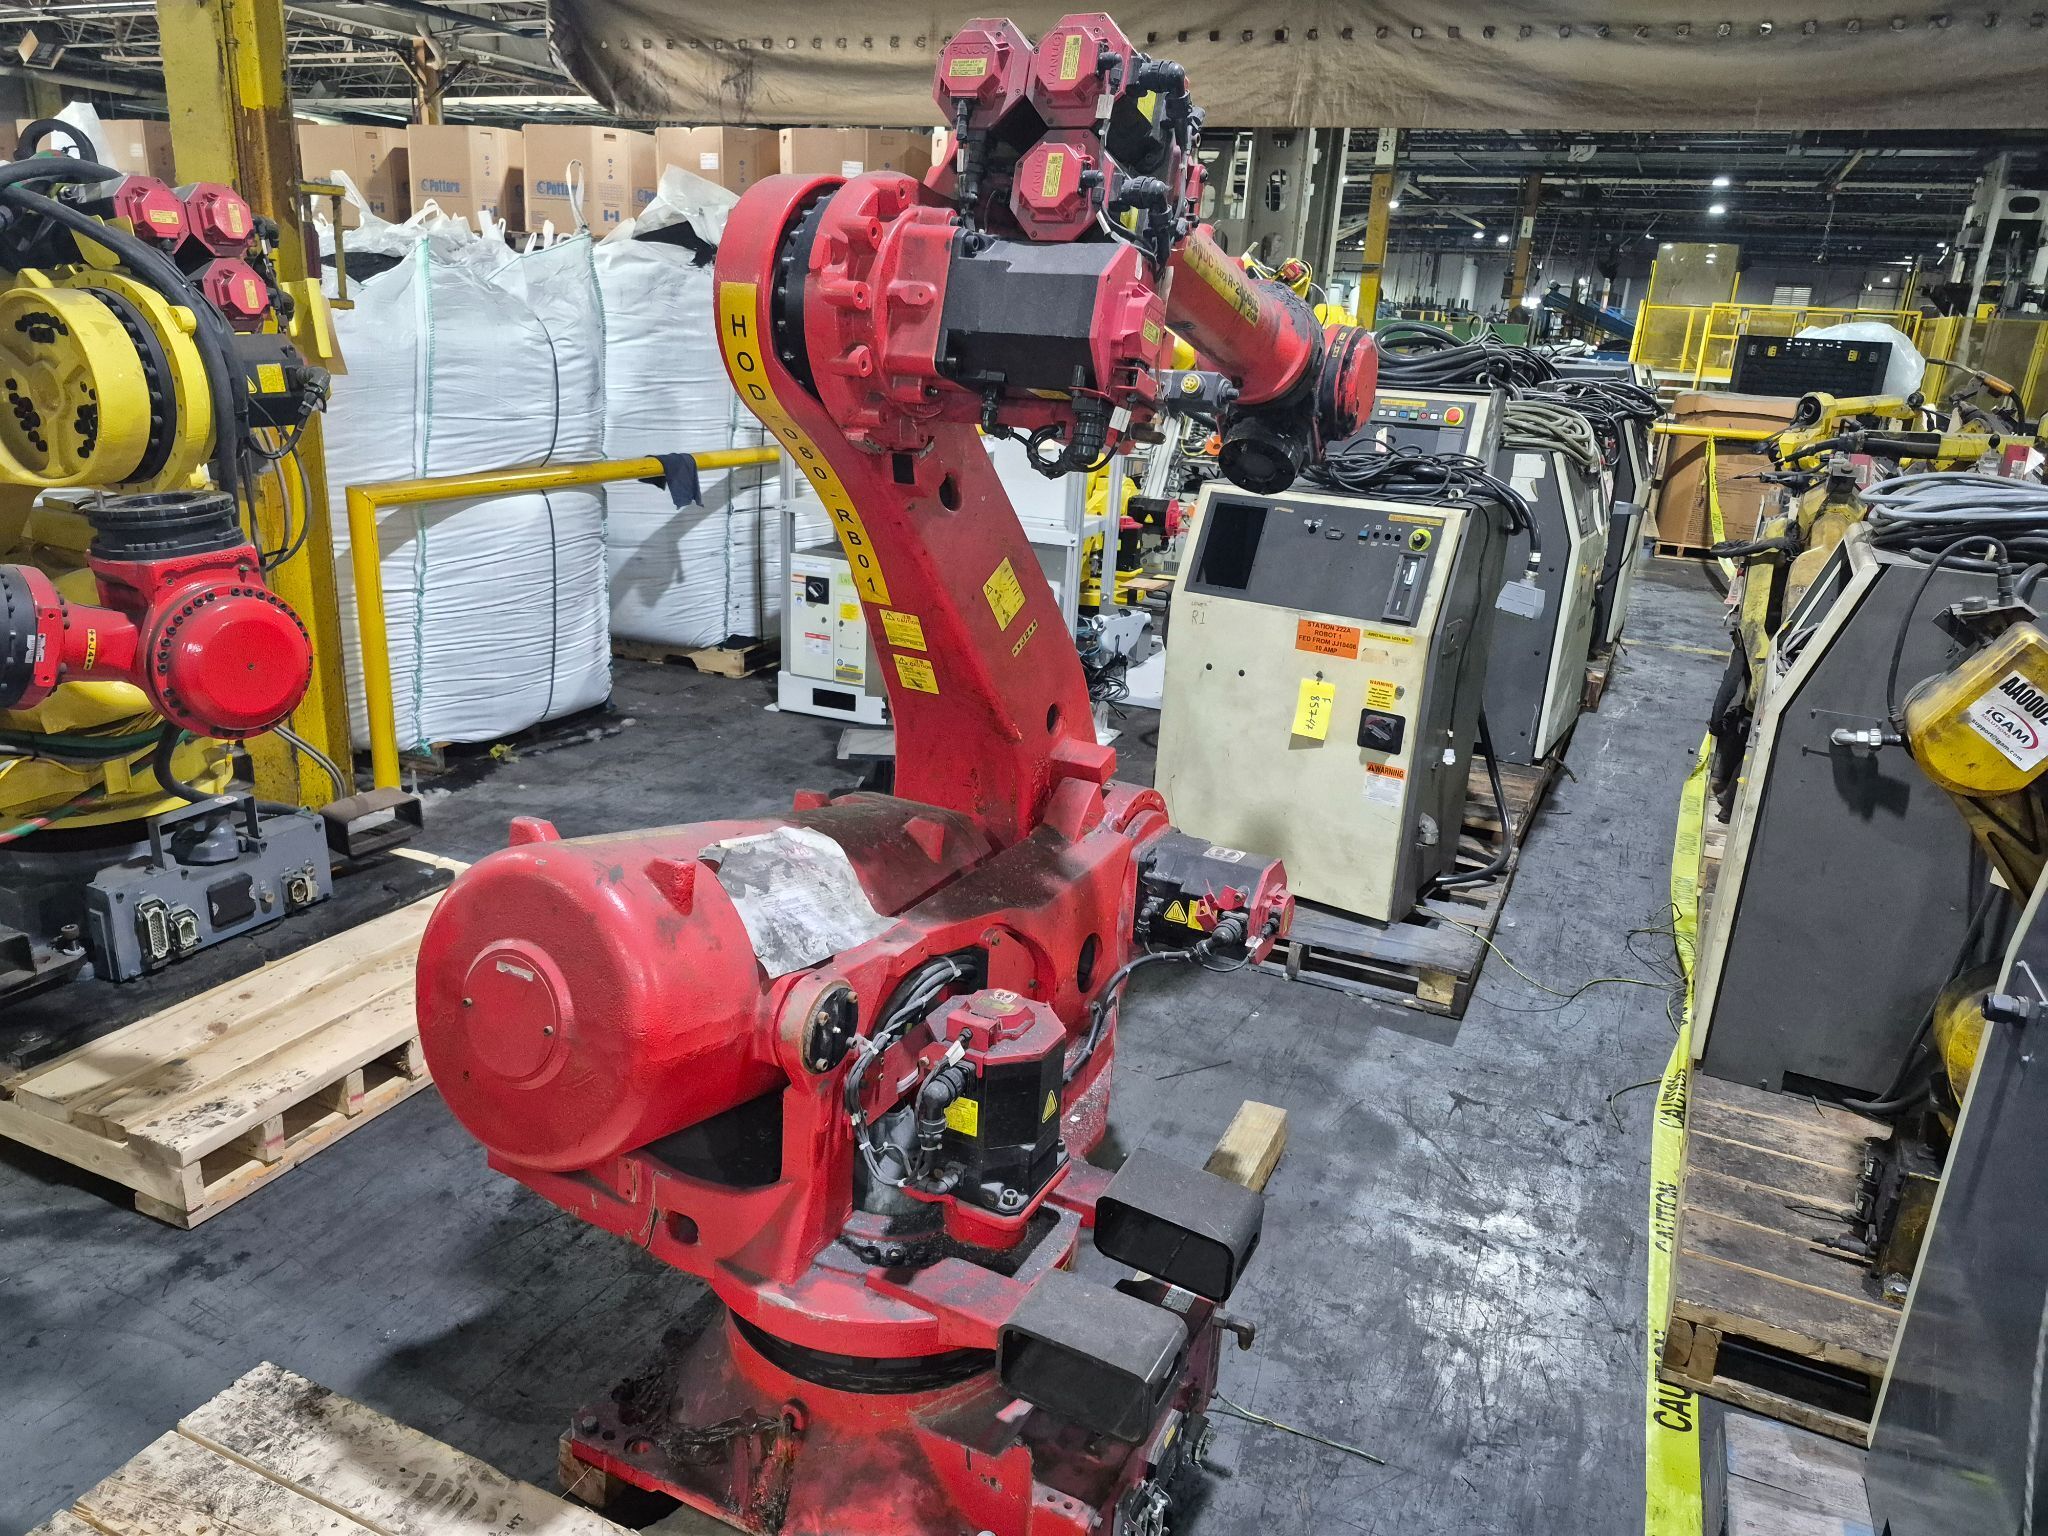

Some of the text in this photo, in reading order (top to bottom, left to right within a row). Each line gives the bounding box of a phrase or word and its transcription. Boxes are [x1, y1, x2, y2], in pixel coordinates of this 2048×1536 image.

[1381, 140, 1390, 152] 5
[430, 179, 460, 193] Potters
[731, 314, 877, 593] HOD-080-RB01
[1191, 610, 1205, 625] R1
[1307, 621, 1335, 630] STATION
[1312, 636, 1331, 645] FROM
[1314, 630, 1336, 639] ROBOT
[1369, 679, 1394, 689] WARNING
[1971, 718, 2023, 762] support@igam.com
[1374, 765, 1405, 779] WARNING
[1659, 1067, 1687, 1129] CAUTION
[505, 1513, 525, 1530] HT
